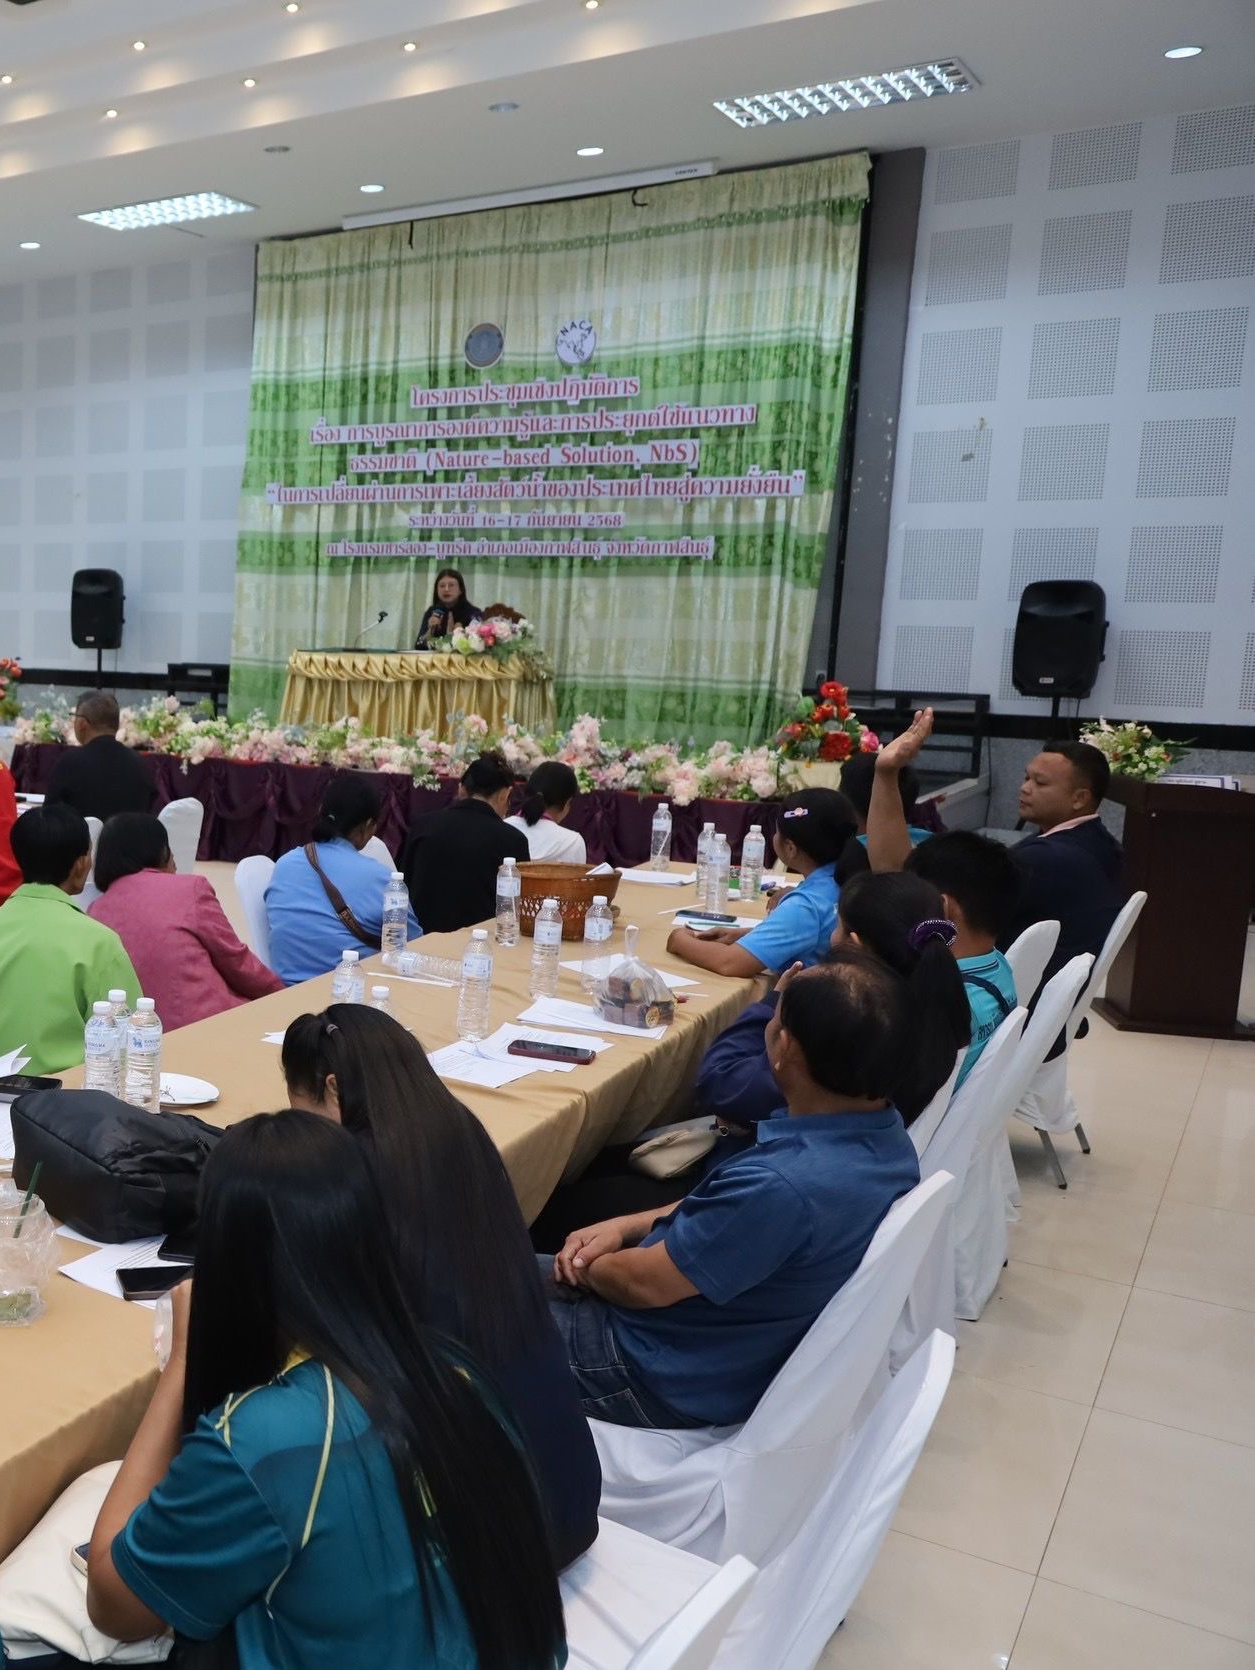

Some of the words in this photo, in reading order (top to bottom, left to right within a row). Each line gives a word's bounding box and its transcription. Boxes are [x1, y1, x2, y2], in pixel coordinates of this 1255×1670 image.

[560, 320, 593, 336] NACA
[412, 376, 638, 407] โครงการประชุมเชิงปฏิบัติการ
[310, 418, 340, 442] เรื่อง
[351, 449, 417, 470] ธรรมชาติ
[650, 442, 697, 464] NbS)
[483, 515, 521, 526] 16-17
[528, 511, 581, 526] กันยายน
[588, 514, 622, 526] 2568
